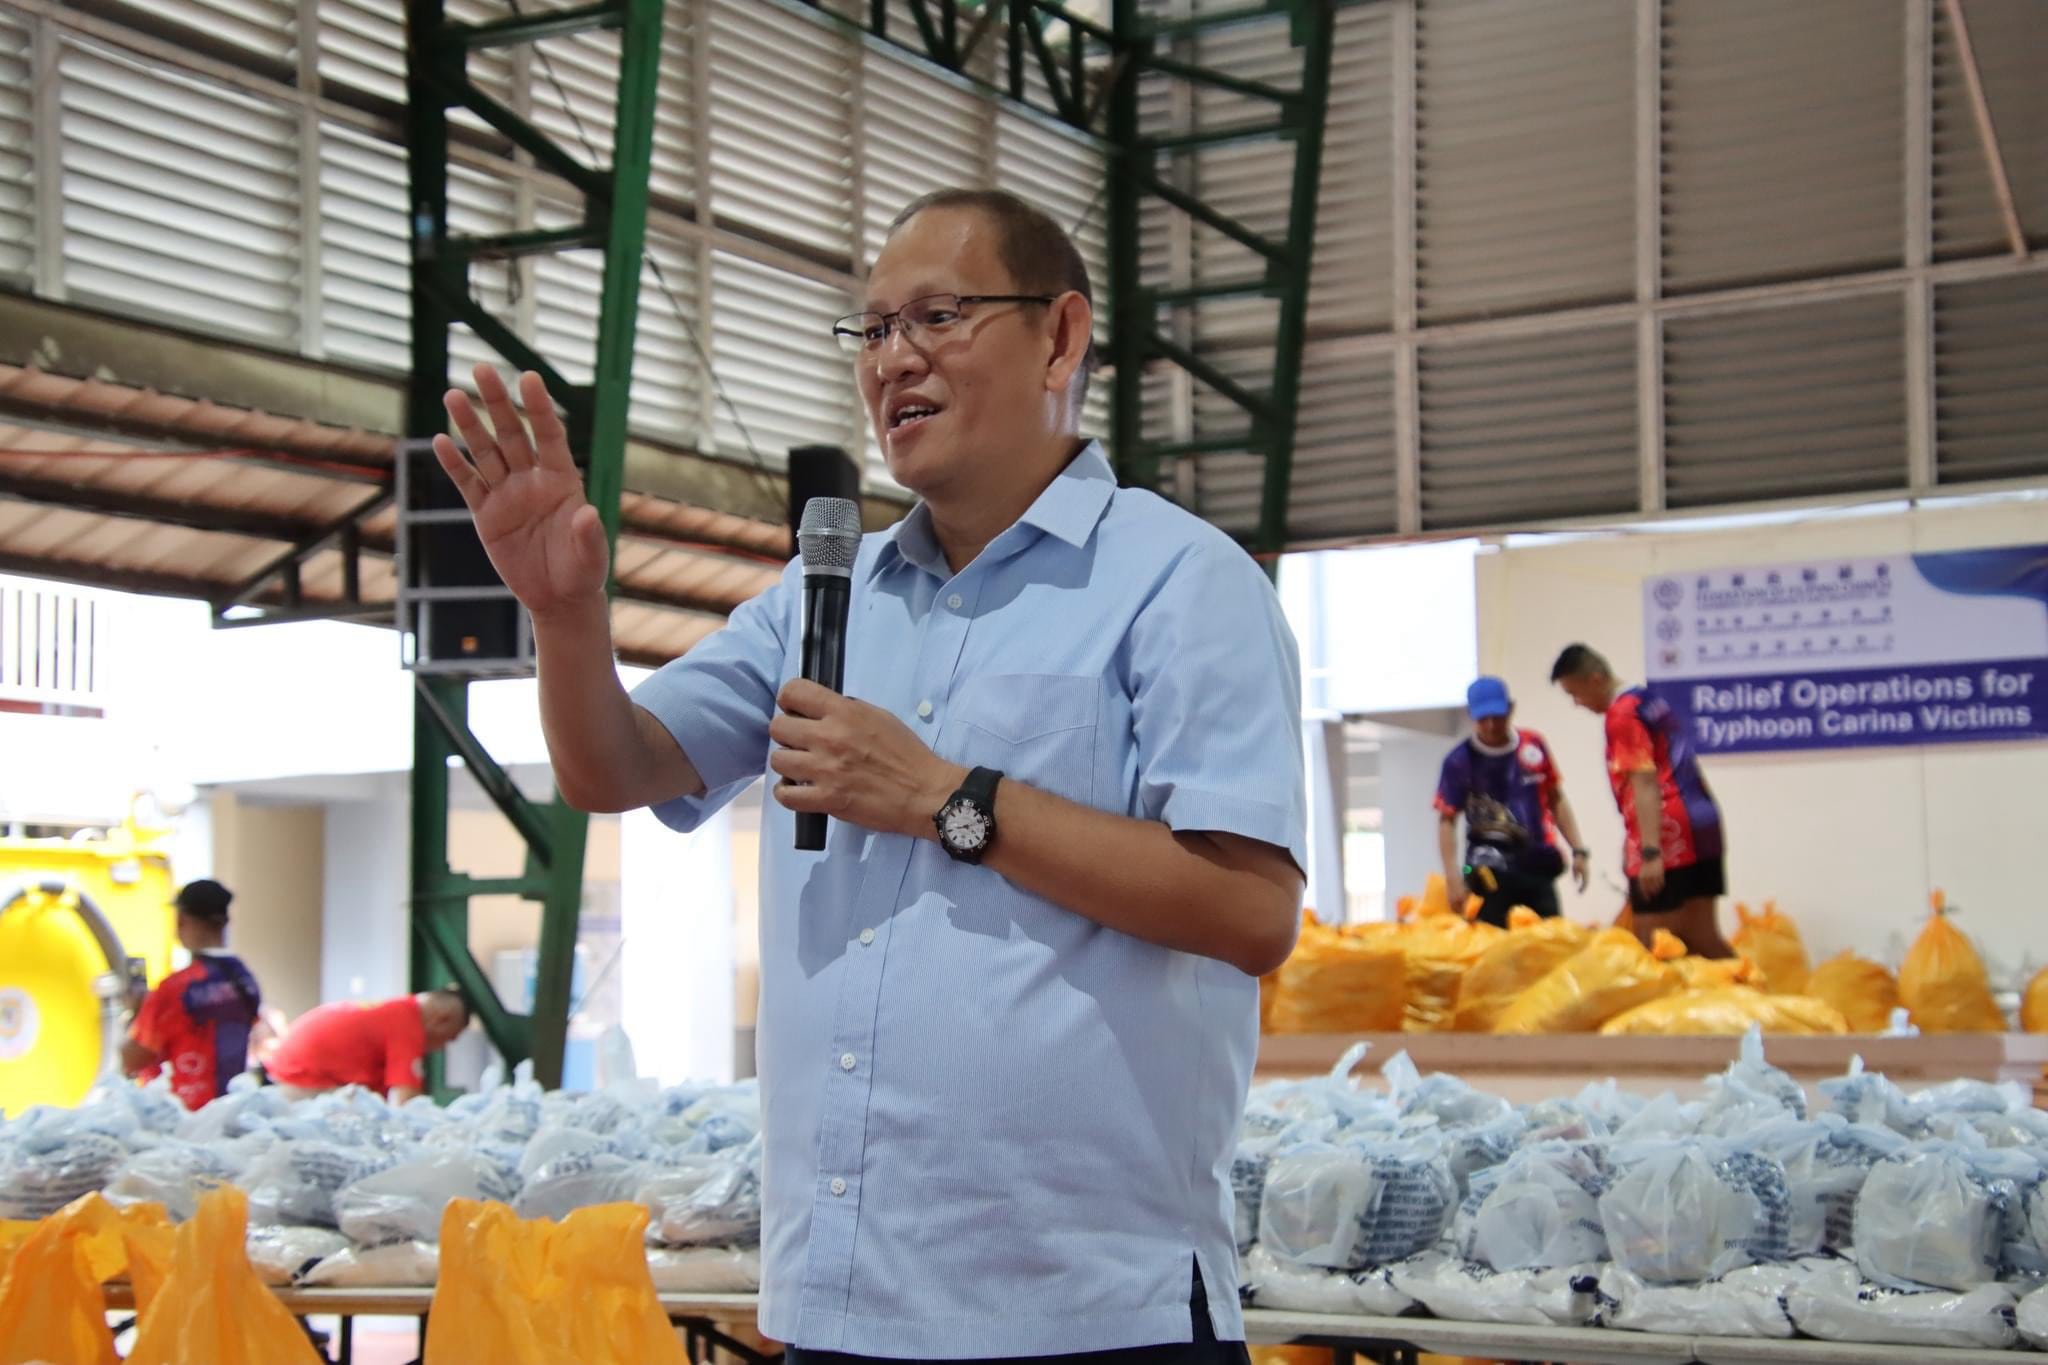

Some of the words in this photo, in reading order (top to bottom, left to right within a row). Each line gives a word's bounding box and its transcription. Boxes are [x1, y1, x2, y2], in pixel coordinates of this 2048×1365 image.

[1694, 681, 1784, 712] Relief
[1793, 674, 1973, 709] Operations
[1983, 669, 2034, 696] for
[1696, 714, 1812, 746] Typhoon
[1820, 708, 1913, 735] Carina
[1921, 702, 2033, 731] Victims
